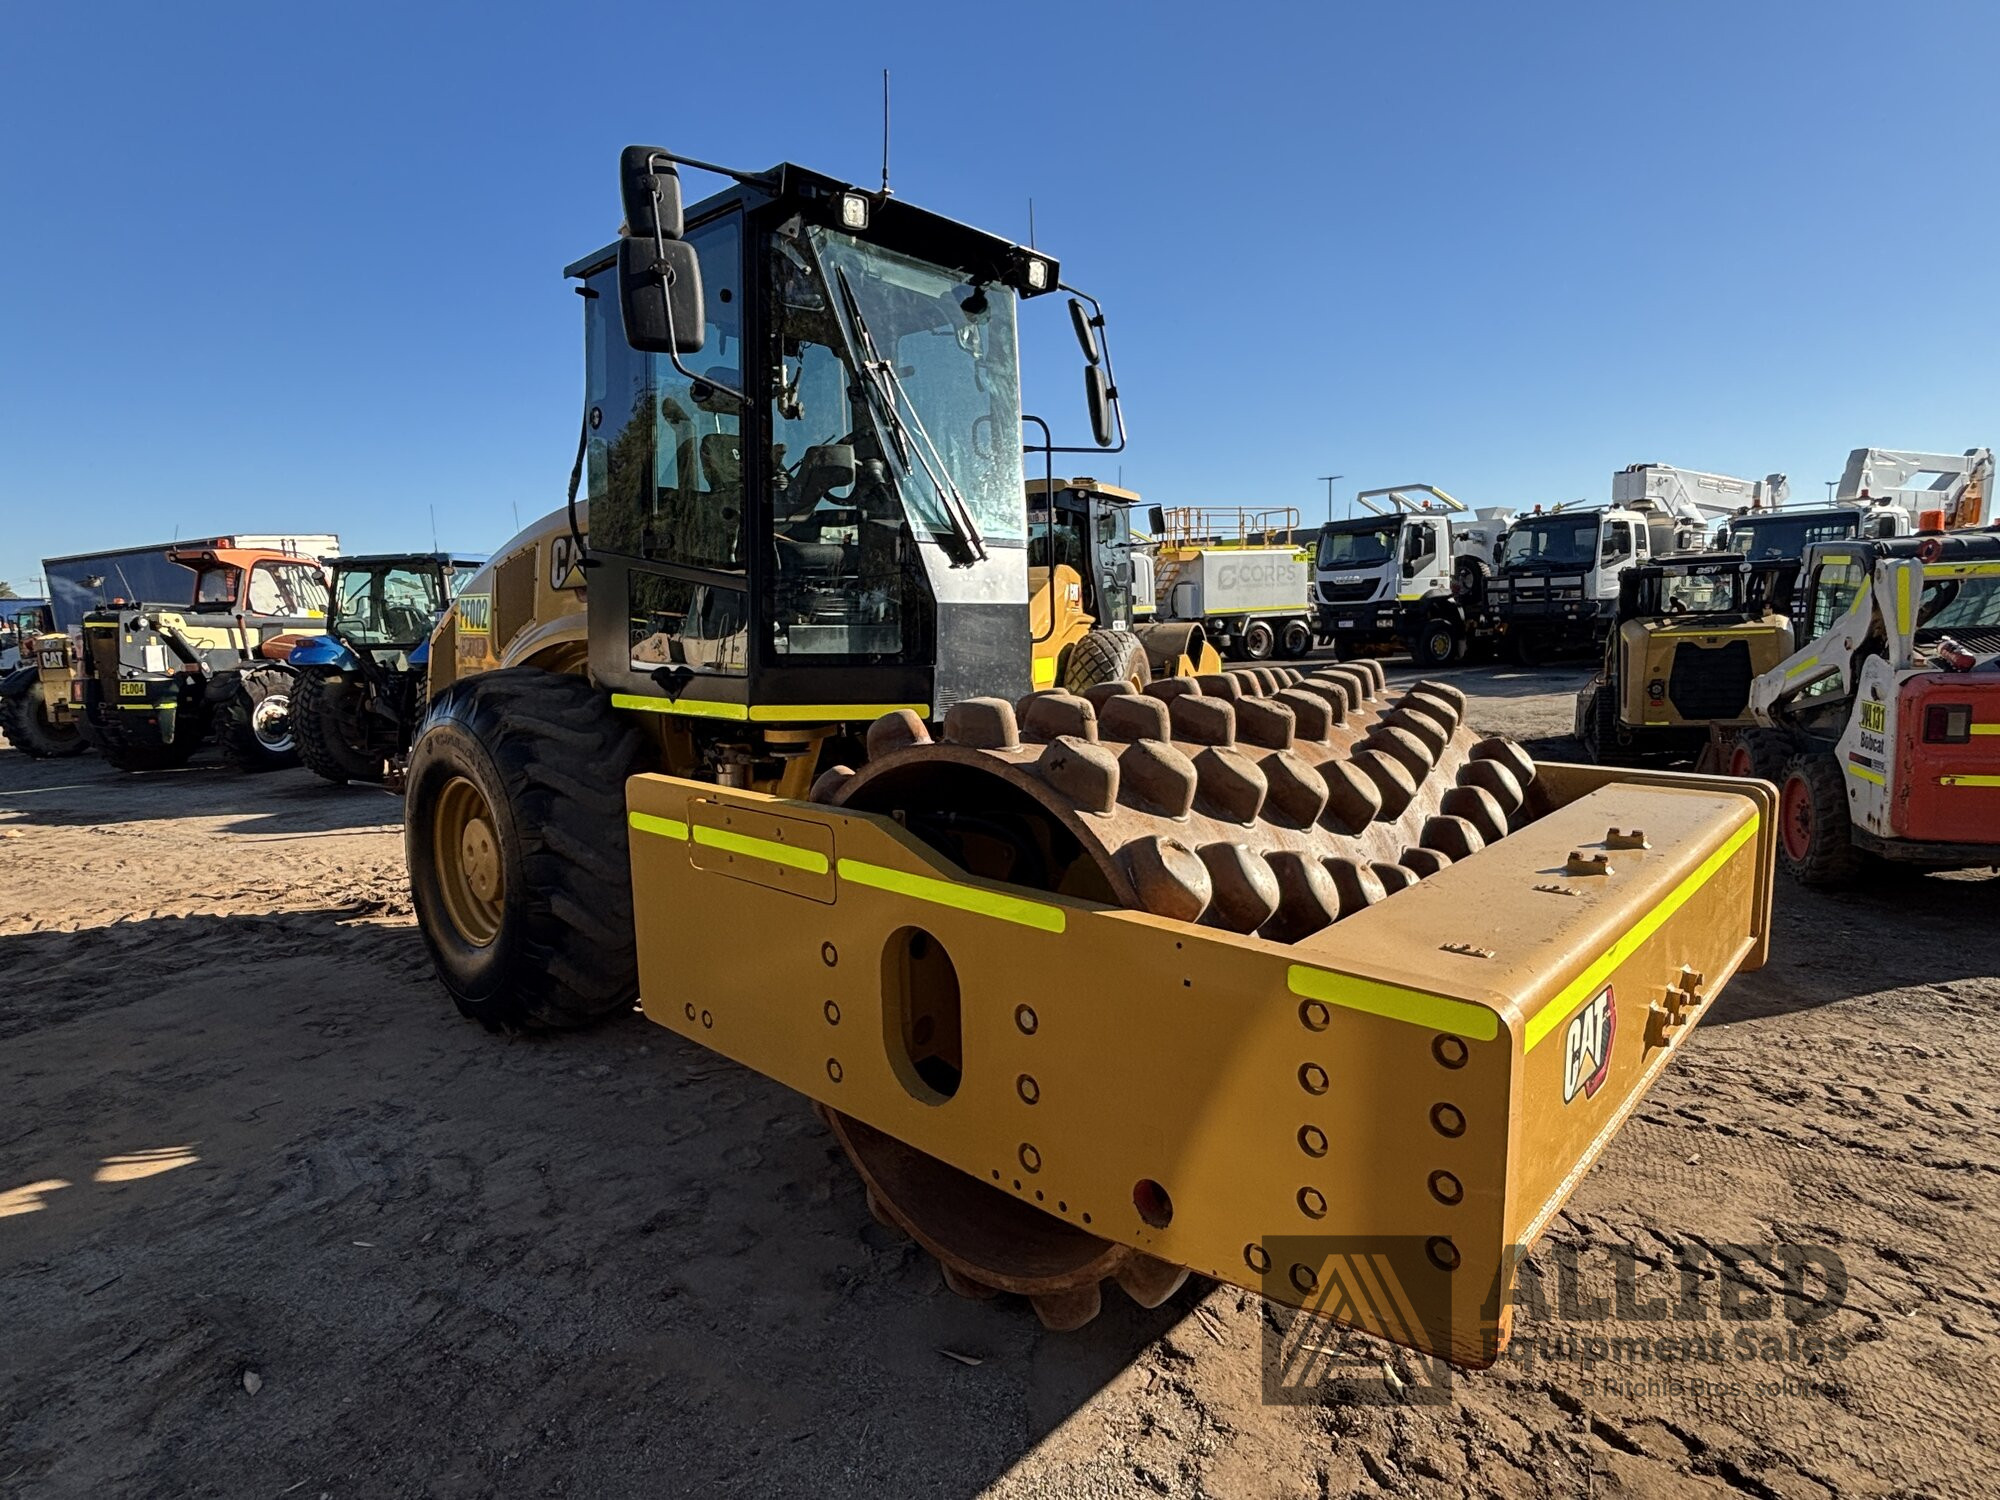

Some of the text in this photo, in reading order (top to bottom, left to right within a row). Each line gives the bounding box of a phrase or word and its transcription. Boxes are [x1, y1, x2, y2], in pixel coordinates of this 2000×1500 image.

[1240, 565, 1296, 582] CORPS
[461, 599, 488, 629] PF002
[42, 651, 63, 668] CAT
[121, 683, 144, 695] FL004
[1861, 731, 1884, 754] Bobcat
[1564, 989, 1609, 1102] CAT
